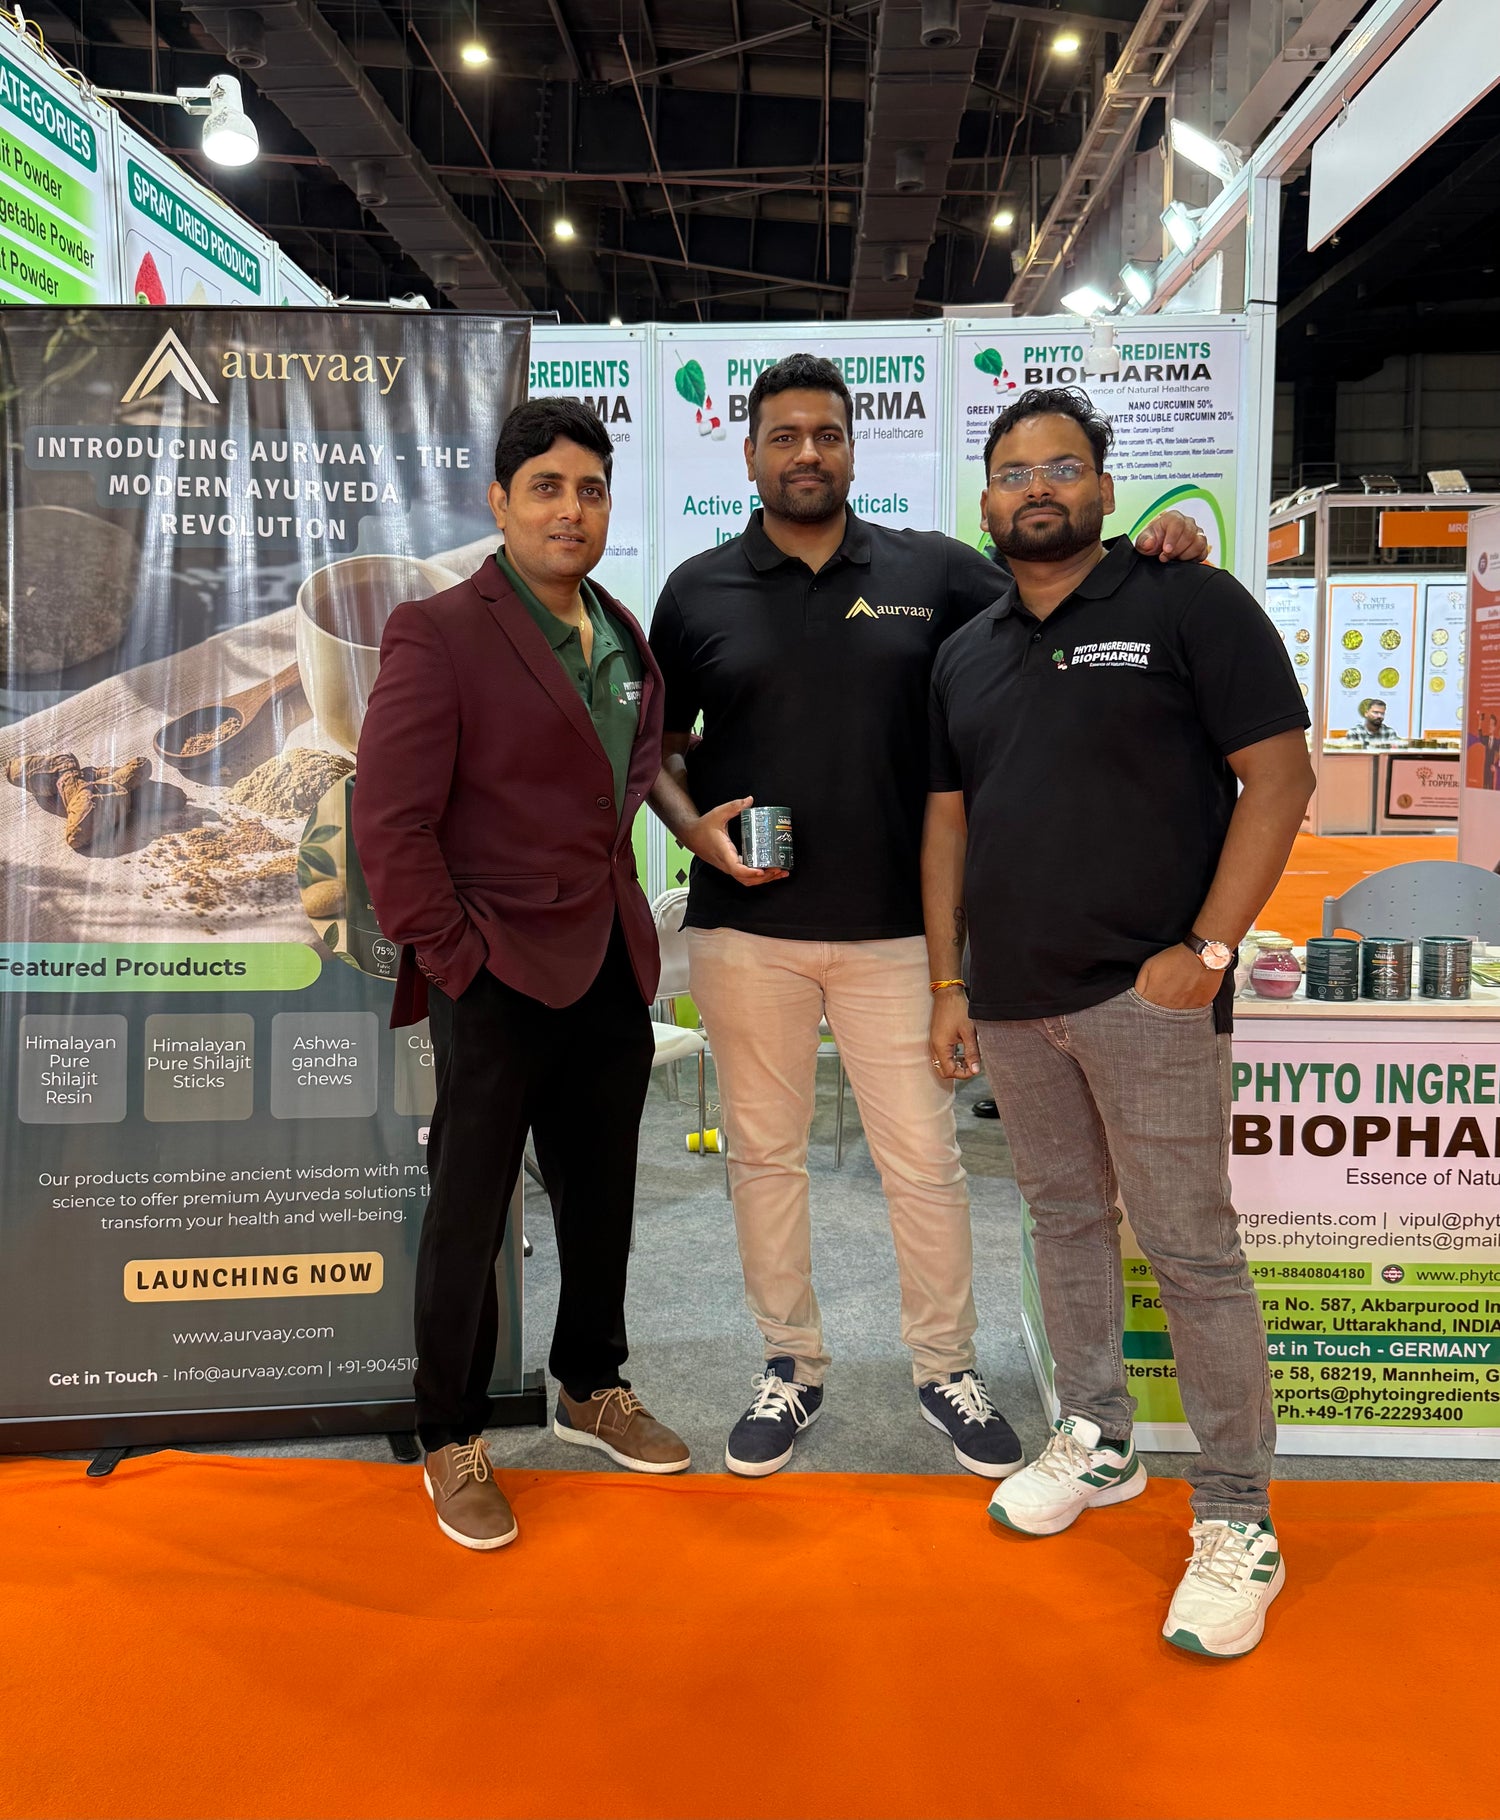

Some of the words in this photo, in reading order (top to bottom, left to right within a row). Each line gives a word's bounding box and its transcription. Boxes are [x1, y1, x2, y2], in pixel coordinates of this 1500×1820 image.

[14, 147, 62, 200] Powder
[133, 171, 173, 225] SPRAY
[175, 203, 209, 251] DRIED
[210, 230, 258, 287] PRODUCT
[50, 222, 94, 269] Powder
[10, 249, 59, 298] Powder
[1024, 345, 1084, 363] PHYTO
[221, 348, 407, 395] aurvaay
[1128, 384, 1160, 394] Natural
[1162, 385, 1210, 394] Healthcare
[967, 405, 994, 415] GREEN
[1129, 401, 1151, 411] NANO
[1153, 400, 1195, 410] CURCUMIN
[1197, 400, 1214, 409] 50%
[1136, 413, 1172, 423] SOLUBLE
[1174, 412, 1216, 422] CURCUMIN
[1218, 411, 1234, 421] 20%
[875, 427, 924, 440] Healthcare
[36, 436, 239, 461] INTRODUCING
[251, 443, 385, 466] AURVAAY
[416, 446, 472, 469] THE
[108, 474, 232, 498] MODERN
[245, 479, 399, 504] AYURVEDA
[683, 495, 742, 515] Active
[161, 513, 347, 540] REVOLUTION
[875, 603, 934, 622] aurvaay
[1073, 644, 1098, 655] PHYTO
[1099, 641, 1151, 654] INGREDIENTS
[1071, 652, 1149, 665] BIOPHARMA
[375, 946, 395, 956] 75%
[116, 957, 247, 977] Prouducts
[25, 1035, 117, 1052] Himalayan
[152, 1037, 247, 1054] Himalayan
[293, 1036, 357, 1051] Ashwa-
[408, 1036, 433, 1049] Cu
[49, 1055, 90, 1069] Pure
[147, 1057, 190, 1071] Pure
[193, 1055, 252, 1073] Shilajit
[292, 1053, 358, 1070] gandha
[41, 1071, 98, 1089] Shilajit
[173, 1073, 225, 1089] Sticks
[297, 1071, 353, 1086] chews
[1231, 1063, 1361, 1104] PHYTO
[1375, 1063, 1500, 1105] INGRE
[45, 1090, 93, 1105] Resin
[1232, 1114, 1500, 1158] BIOPHA
[38, 1172, 72, 1187] Our
[75, 1170, 149, 1189] products
[153, 1167, 226, 1184] combine
[230, 1166, 292, 1181] ancient
[296, 1164, 360, 1180] wisdom
[364, 1163, 399, 1177] with
[1346, 1168, 1427, 1186] Essence
[1434, 1169, 1453, 1186] of
[52, 1193, 116, 1209] science
[119, 1195, 137, 1208] to
[140, 1192, 179, 1207] offer
[183, 1190, 260, 1208] premium
[263, 1186, 340, 1205] Ayurveda
[345, 1184, 417, 1200] solutions
[101, 1212, 184, 1230] transform
[186, 1213, 223, 1229] your
[227, 1208, 280, 1226] health
[284, 1208, 317, 1224] and
[319, 1207, 408, 1225] well-being.
[1237, 1211, 1376, 1229] ngredients.com
[136, 1265, 300, 1290] LAUNCHING
[310, 1262, 373, 1283] NOW
[1252, 1267, 1365, 1280] +91-8840804180
[1259, 1299, 1280, 1311] ra
[1285, 1297, 1315, 1311] No.
[1320, 1298, 1355, 1313] 587,
[1361, 1298, 1479, 1316] Akbarpurood
[172, 1323, 335, 1345] www.aurvaay.com
[1263, 1316, 1327, 1333] ridwar,
[1332, 1318, 1447, 1335] Uttarakhand,
[1452, 1318, 1500, 1332] INDIA
[1291, 1341, 1307, 1356] in
[1314, 1341, 1371, 1357] Touch
[1389, 1342, 1491, 1358] GERMANY
[49, 1371, 80, 1386] Get
[84, 1370, 100, 1385] in
[105, 1369, 158, 1384] Touch
[173, 1361, 323, 1383] Info@aurvaay.com
[1289, 1366, 1315, 1382] 58,
[1320, 1367, 1377, 1384] 68219,
[1382, 1368, 1479, 1384] Mannheim,
[1272, 1386, 1500, 1405] xports@phytoingredients
[1277, 1404, 1463, 1422] Ph.+49-176-22293400
